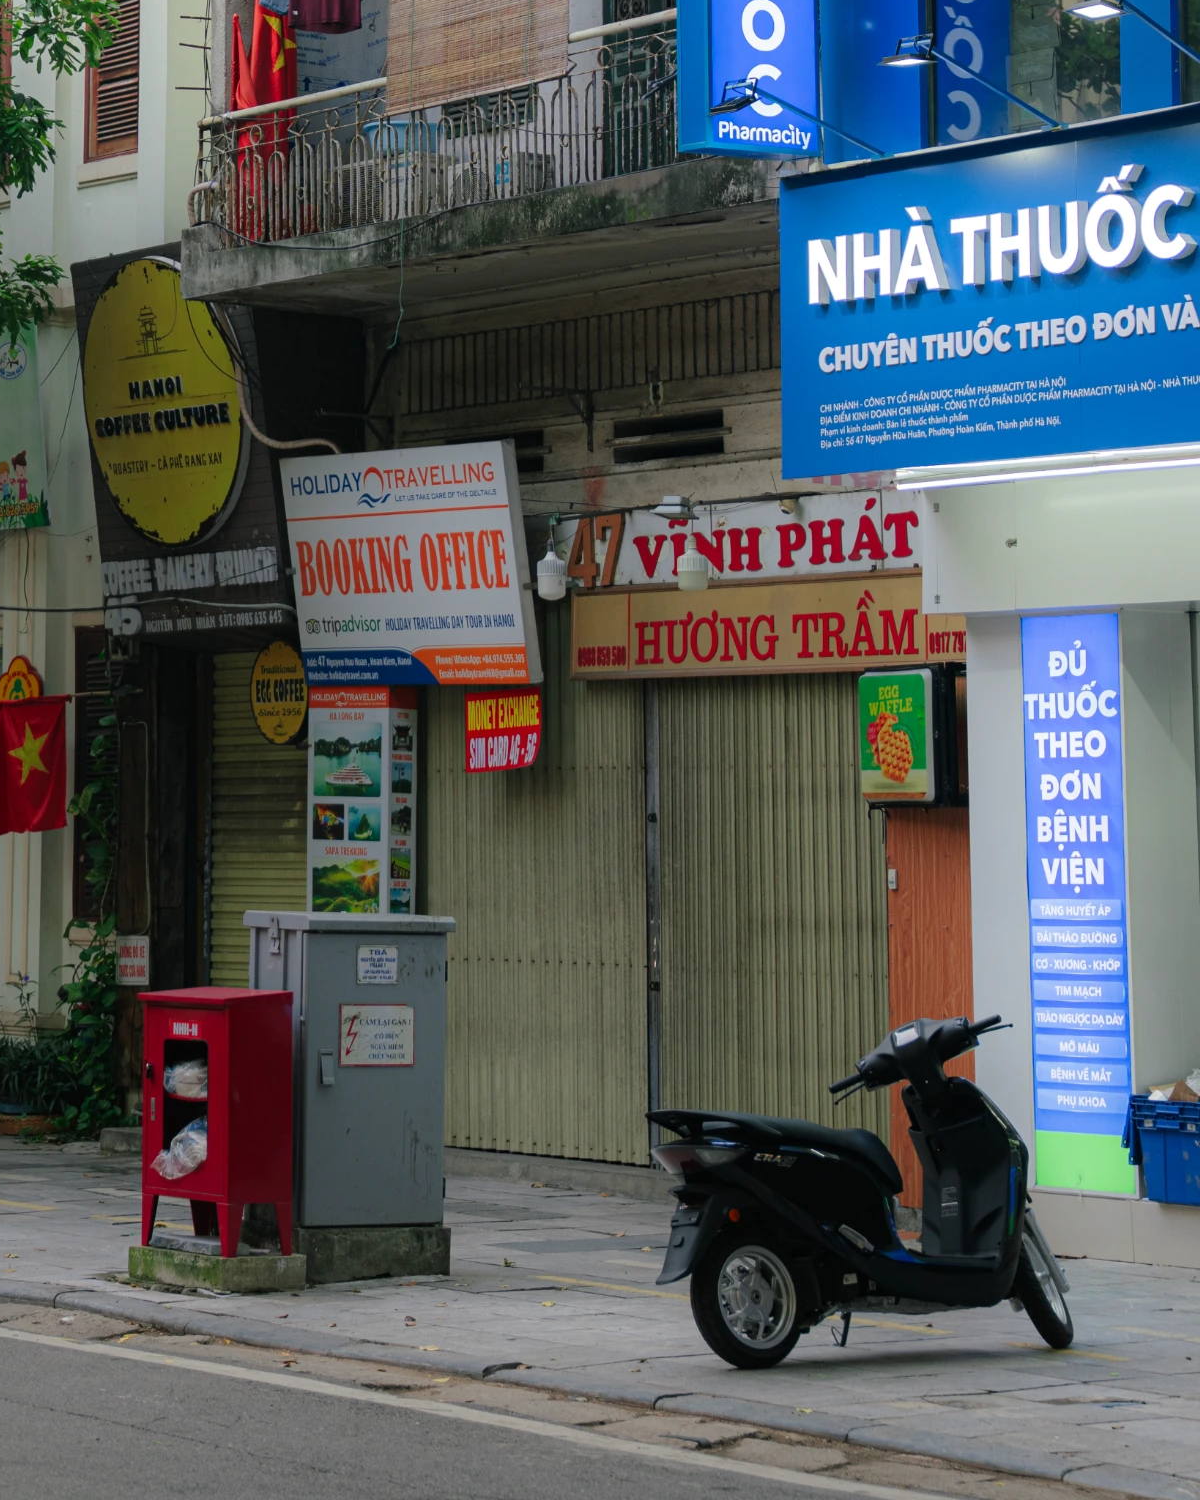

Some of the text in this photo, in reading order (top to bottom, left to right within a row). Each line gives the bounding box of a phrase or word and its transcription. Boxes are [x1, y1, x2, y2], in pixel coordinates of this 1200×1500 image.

[718, 120, 811, 150] Pharmacity
[808, 163, 1197, 305] NHÀ THUỐC
[818, 294, 1200, 373] CHUYÊN THUỐC THEO ĐƠN VÀ
[128, 375, 183, 401] HANOI
[820, 376, 1066, 413] CHI NHÁNH CÔNG TY CỔ PHẦN DƯỢC PHẨM PHARMACITY TẠI HÀ NỘI
[95, 401, 231, 439] COFFEE CULTURE
[820, 440, 831, 450] Địa
[846, 436, 854, 445] Số
[856, 435, 864, 444] 47
[866, 431, 892, 445] Nguyễn
[893, 431, 906, 440] Hữu
[929, 425, 954, 437] Phường
[956, 424, 974, 434] Hoàn
[996, 419, 1018, 430] Thành
[1019, 417, 1034, 430] phố
[1035, 417, 1045, 426] Hà
[158, 451, 167, 470] CÀ
[184, 453, 208, 468] RANG
[208, 451, 223, 466] XAY
[290, 462, 495, 496] HOLIDAY TRAVELLING
[567, 514, 626, 588] 47
[633, 497, 919, 579] VĨNH PHÁT
[102, 546, 278, 595] COFFEE BAKERY BRUNCH
[296, 529, 510, 597] BOOKING OFFICE
[105, 595, 143, 636] 45
[322, 614, 515, 637] tripadvisor HOLIDAY TRAVELLING DAY TOUR IN HANOI
[635, 589, 919, 665] HƯƠNG TRẦM
[929, 628, 950, 654] 0917
[260, 664, 297, 674] Traditional
[1048, 640, 1087, 677] ĐỦ
[255, 678, 305, 704] EGG COFFEE
[311, 692, 386, 701] HOLIDAY TRAVELLING
[878, 685, 899, 700] EGG
[1024, 680, 1118, 720] THUỐC
[258, 707, 302, 717] Since 1956
[353, 712, 365, 720] BAY
[468, 695, 539, 731] MONEY EXCHANGE
[868, 698, 913, 716] WAFFLE
[470, 732, 537, 769] SIM CARD 4G 5G
[1034, 730, 1106, 758] THEO
[1040, 770, 1101, 800] ĐƠN
[1037, 808, 1109, 851] BỆNH
[325, 846, 368, 856] SAPA TREKKING
[1041, 850, 1104, 894] VIỆN
[1040, 902, 1111, 917] TĂNG HUYẾT ÁP
[1037, 930, 1117, 944] ĐÁI THÁO ĐƯỜNG
[1036, 958, 1121, 971] CƠ XƯƠNG KHỚP
[1055, 985, 1102, 1000] TIM MẠCH
[1036, 1010, 1124, 1028] TRÀO NGƯỢC DẠ DÀY
[1060, 1040, 1100, 1054] MỠ MÁU
[1051, 1067, 1112, 1082] BỆNH VỀ MẮT
[1058, 1095, 1106, 1108] PHỤ KHOA
